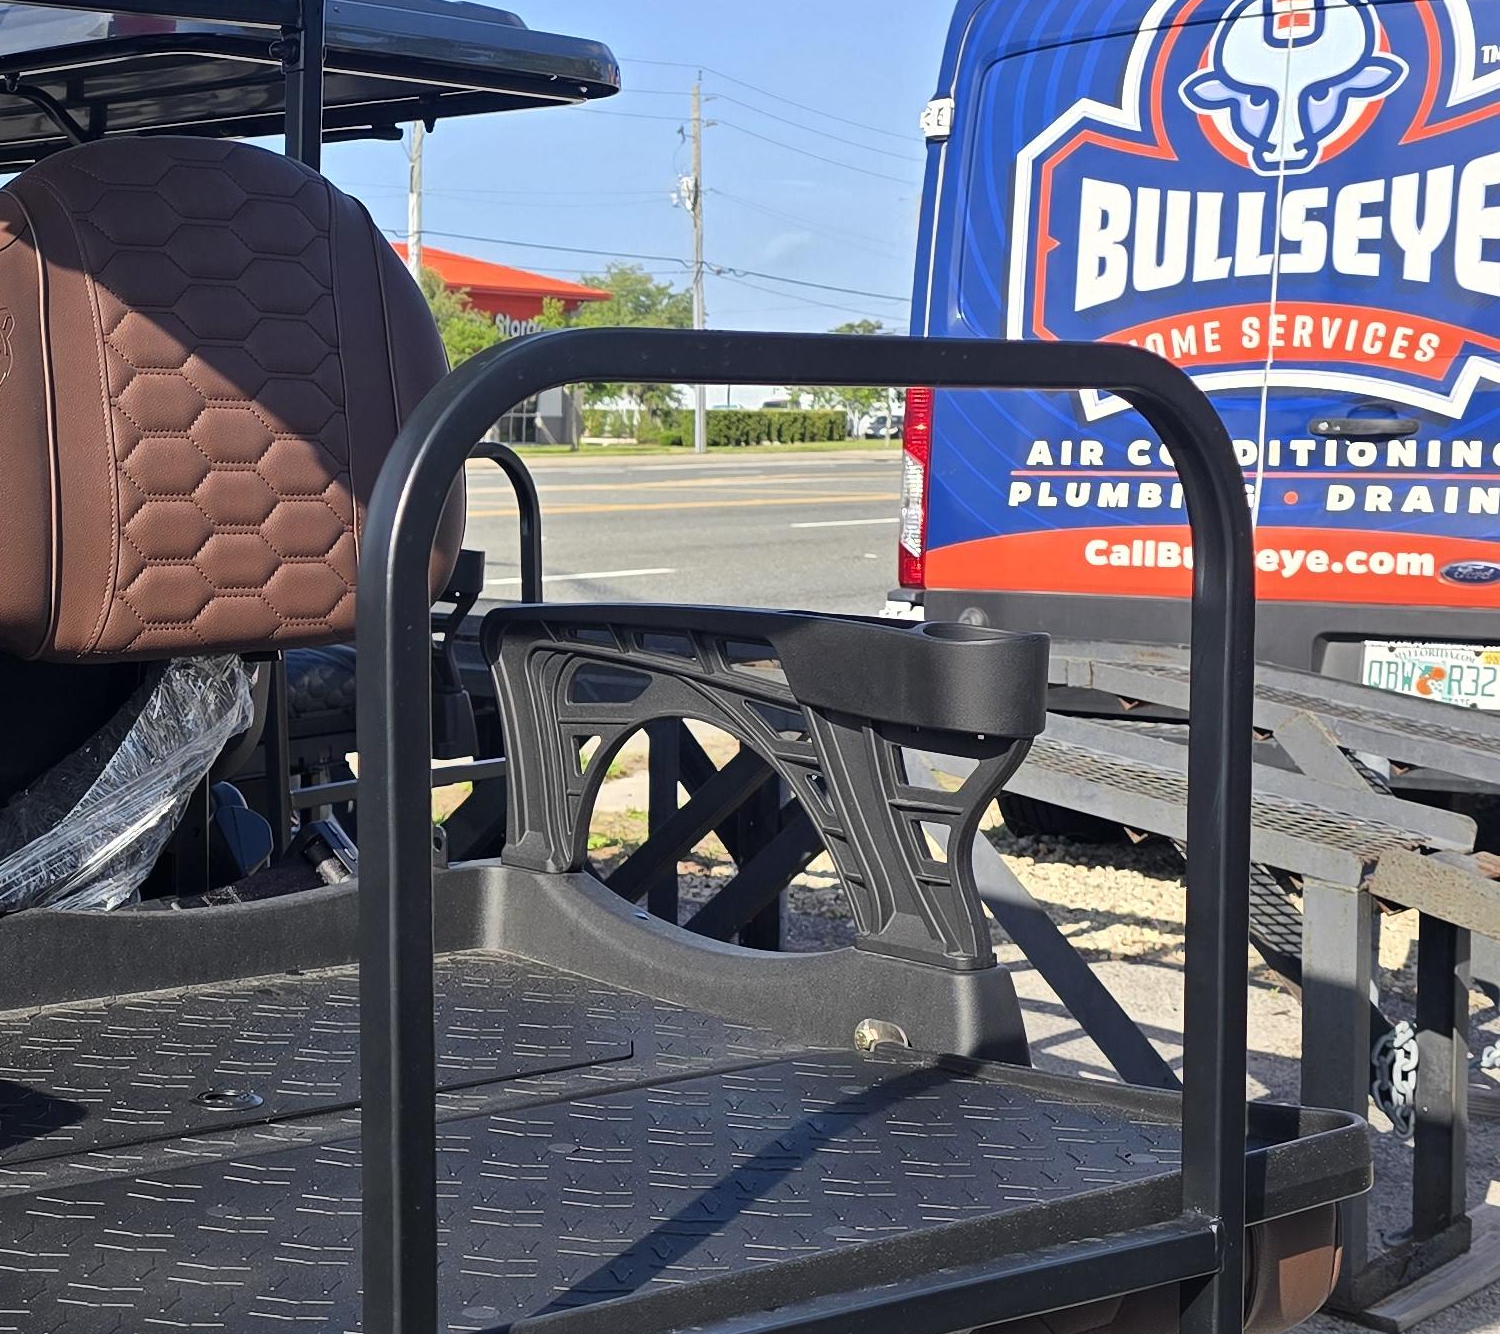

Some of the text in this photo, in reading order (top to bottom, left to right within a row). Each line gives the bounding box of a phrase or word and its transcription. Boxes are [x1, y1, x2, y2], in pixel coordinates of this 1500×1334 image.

[1074, 151, 1500, 312] BULLSEYE
[495, 312, 542, 337] Stora
[1128, 313, 1441, 363] OME SERVICES
[1026, 438, 1500, 470] AIR CDITIONIN
[1008, 481, 1500, 516] PLUMBI DRAIN
[1084, 539, 1435, 578] CallBeye.com
[1453, 564, 1495, 580] Ford
[1447, 664, 1498, 698] R32
